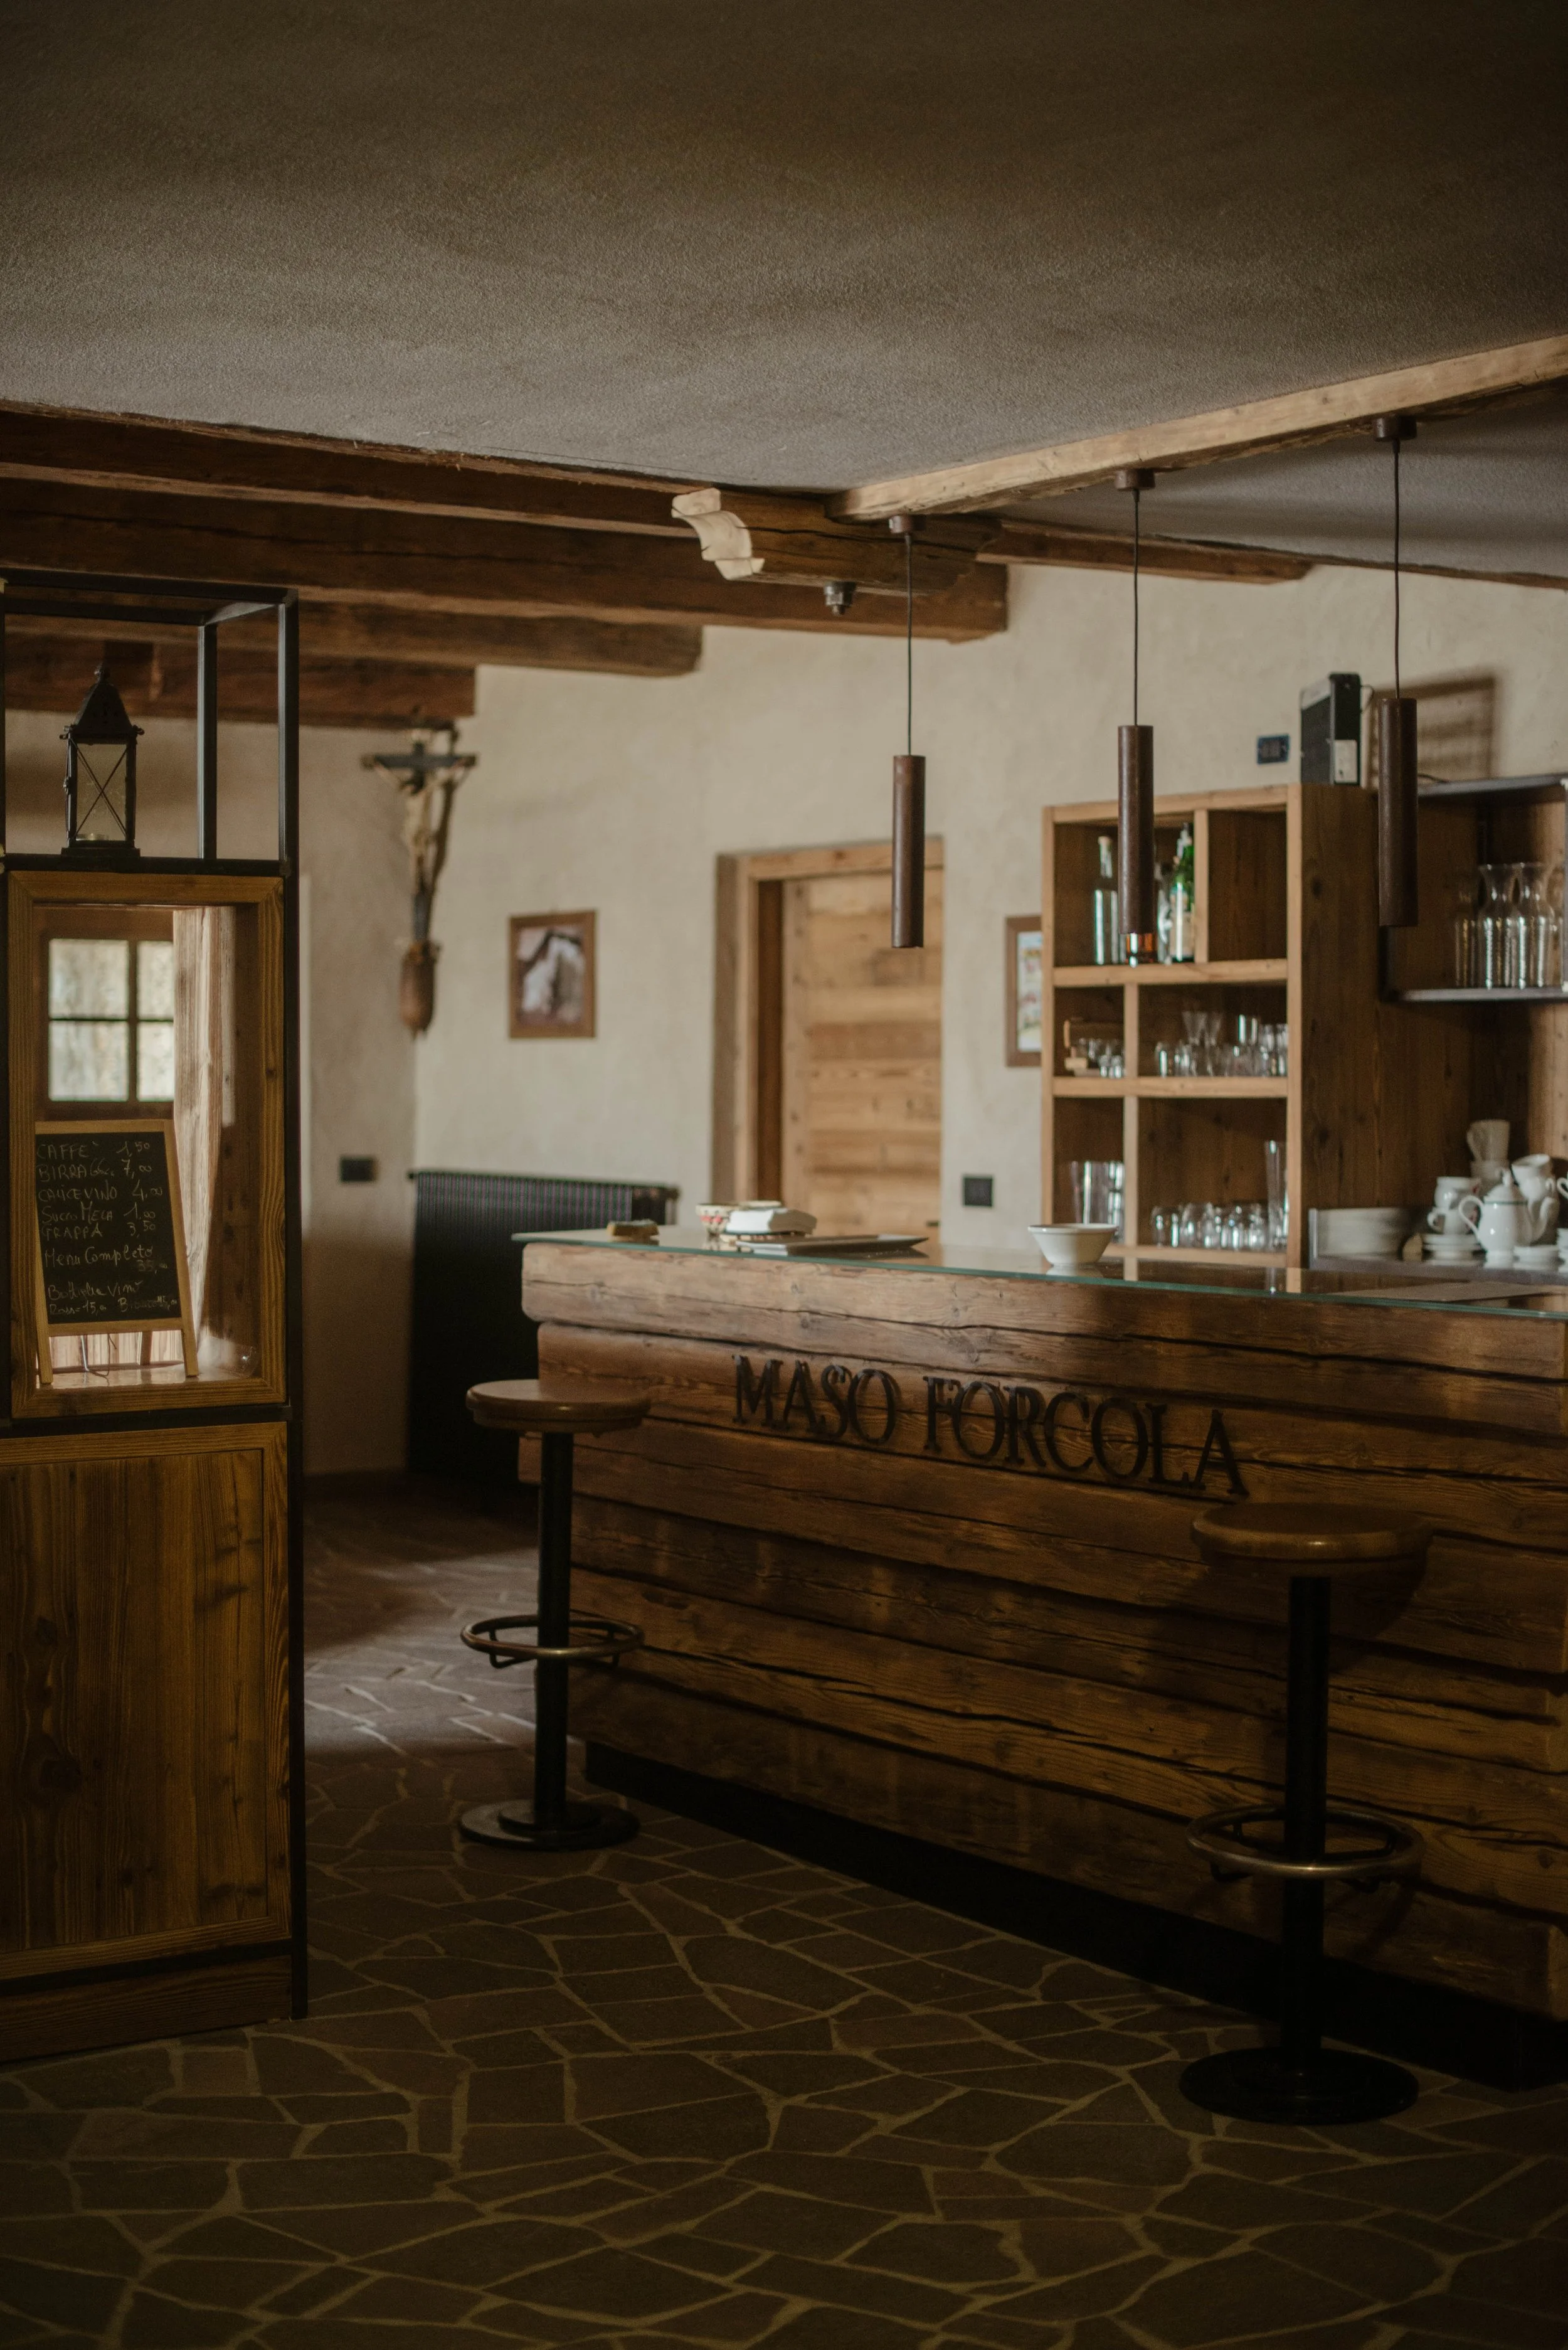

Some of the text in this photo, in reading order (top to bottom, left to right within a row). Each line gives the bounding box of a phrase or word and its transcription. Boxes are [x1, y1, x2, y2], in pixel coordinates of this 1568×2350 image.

[36, 1164, 87, 1182] BIRRA
[84, 1179, 117, 1201] VINO
[733, 1353, 1250, 1497] MASO FORCOLA
